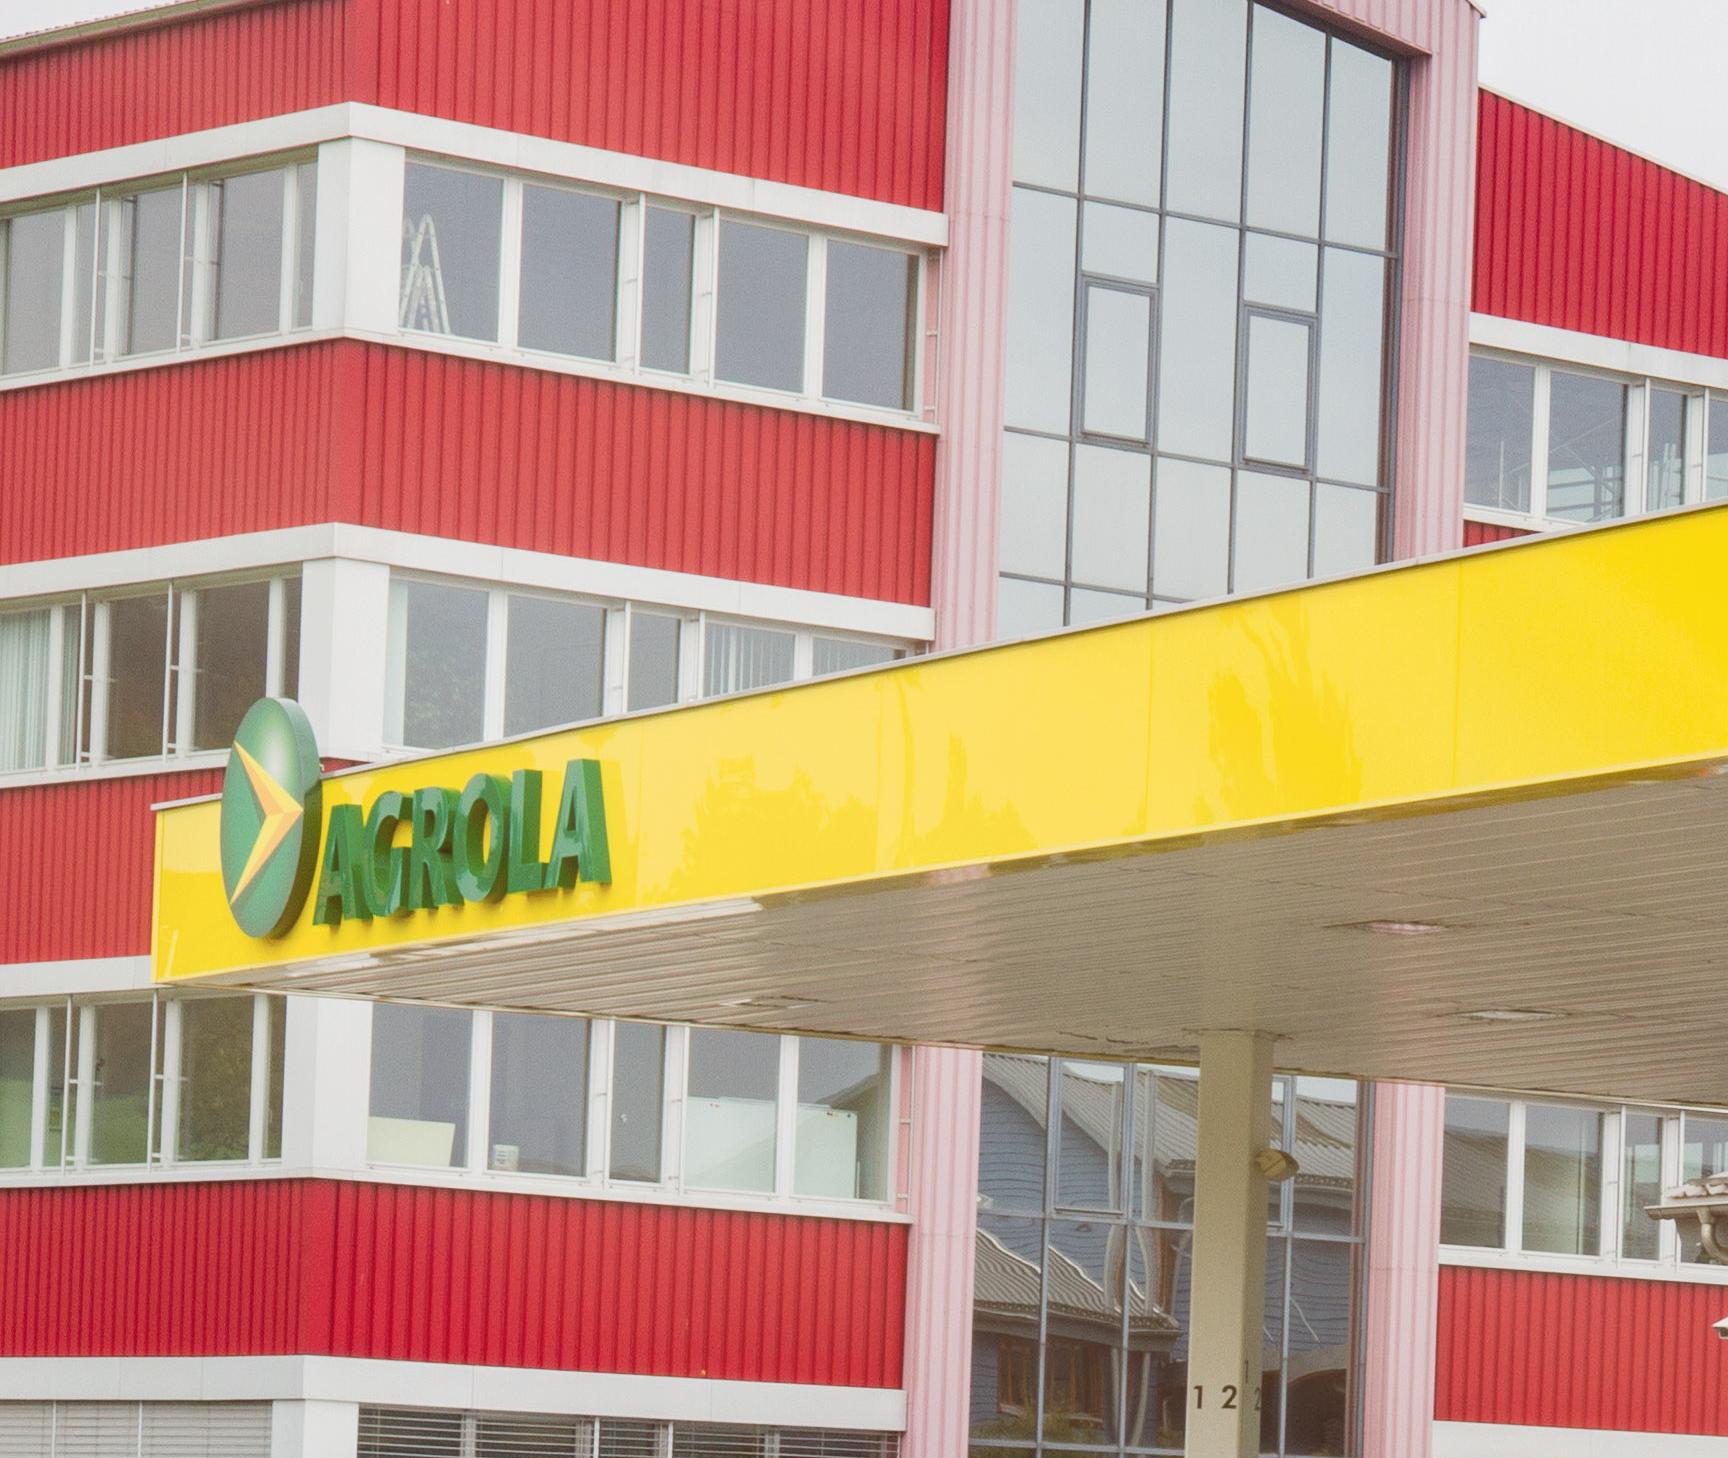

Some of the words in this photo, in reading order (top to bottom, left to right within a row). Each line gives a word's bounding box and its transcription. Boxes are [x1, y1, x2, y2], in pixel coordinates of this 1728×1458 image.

[312, 757, 613, 926] AGROLA
[1193, 1385, 1203, 1409] 1
[1221, 1384, 1237, 1409] 2
